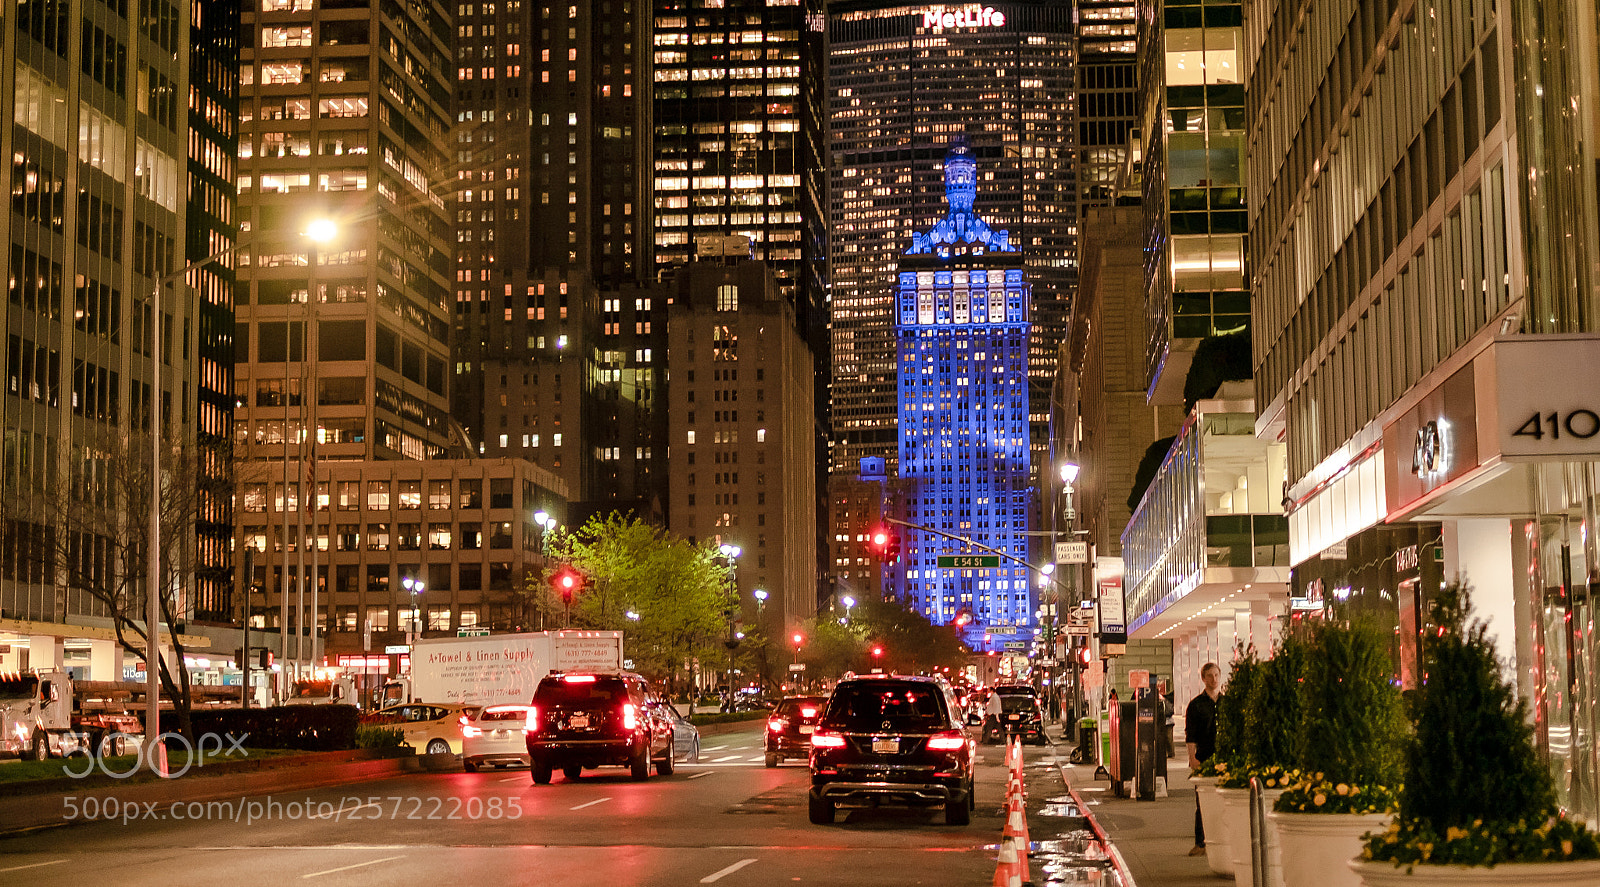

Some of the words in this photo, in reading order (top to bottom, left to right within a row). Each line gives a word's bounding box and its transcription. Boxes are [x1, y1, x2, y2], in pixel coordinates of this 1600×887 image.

[923, 7, 1006, 28] MetLife
[1512, 409, 1600, 440] 410
[953, 557, 959, 566] E
[961, 557, 971, 566] 54
[974, 557, 982, 566] St
[466, 651, 472, 662] &
[476, 650, 500, 661] Linen
[504, 648, 534, 662] Supply
